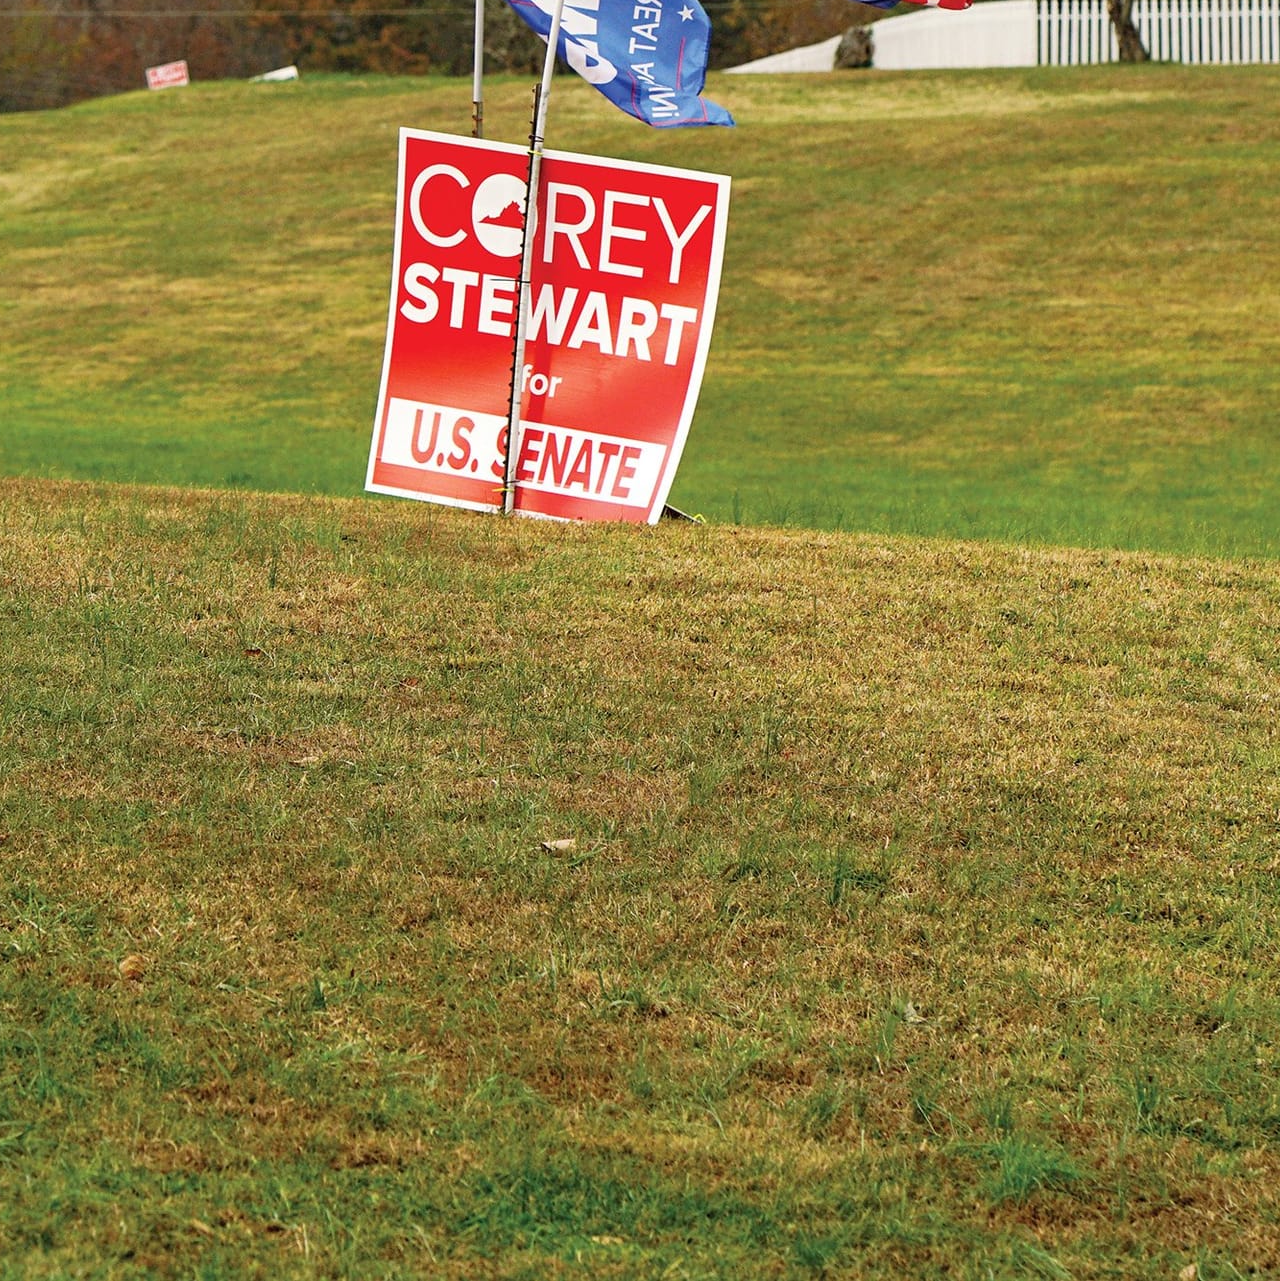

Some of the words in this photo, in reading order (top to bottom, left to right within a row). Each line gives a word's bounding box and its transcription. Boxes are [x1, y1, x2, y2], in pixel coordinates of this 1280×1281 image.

[410, 163, 713, 285] COREY
[400, 262, 699, 366] STEWART
[521, 363, 563, 398] for
[411, 409, 479, 473] U.S.
